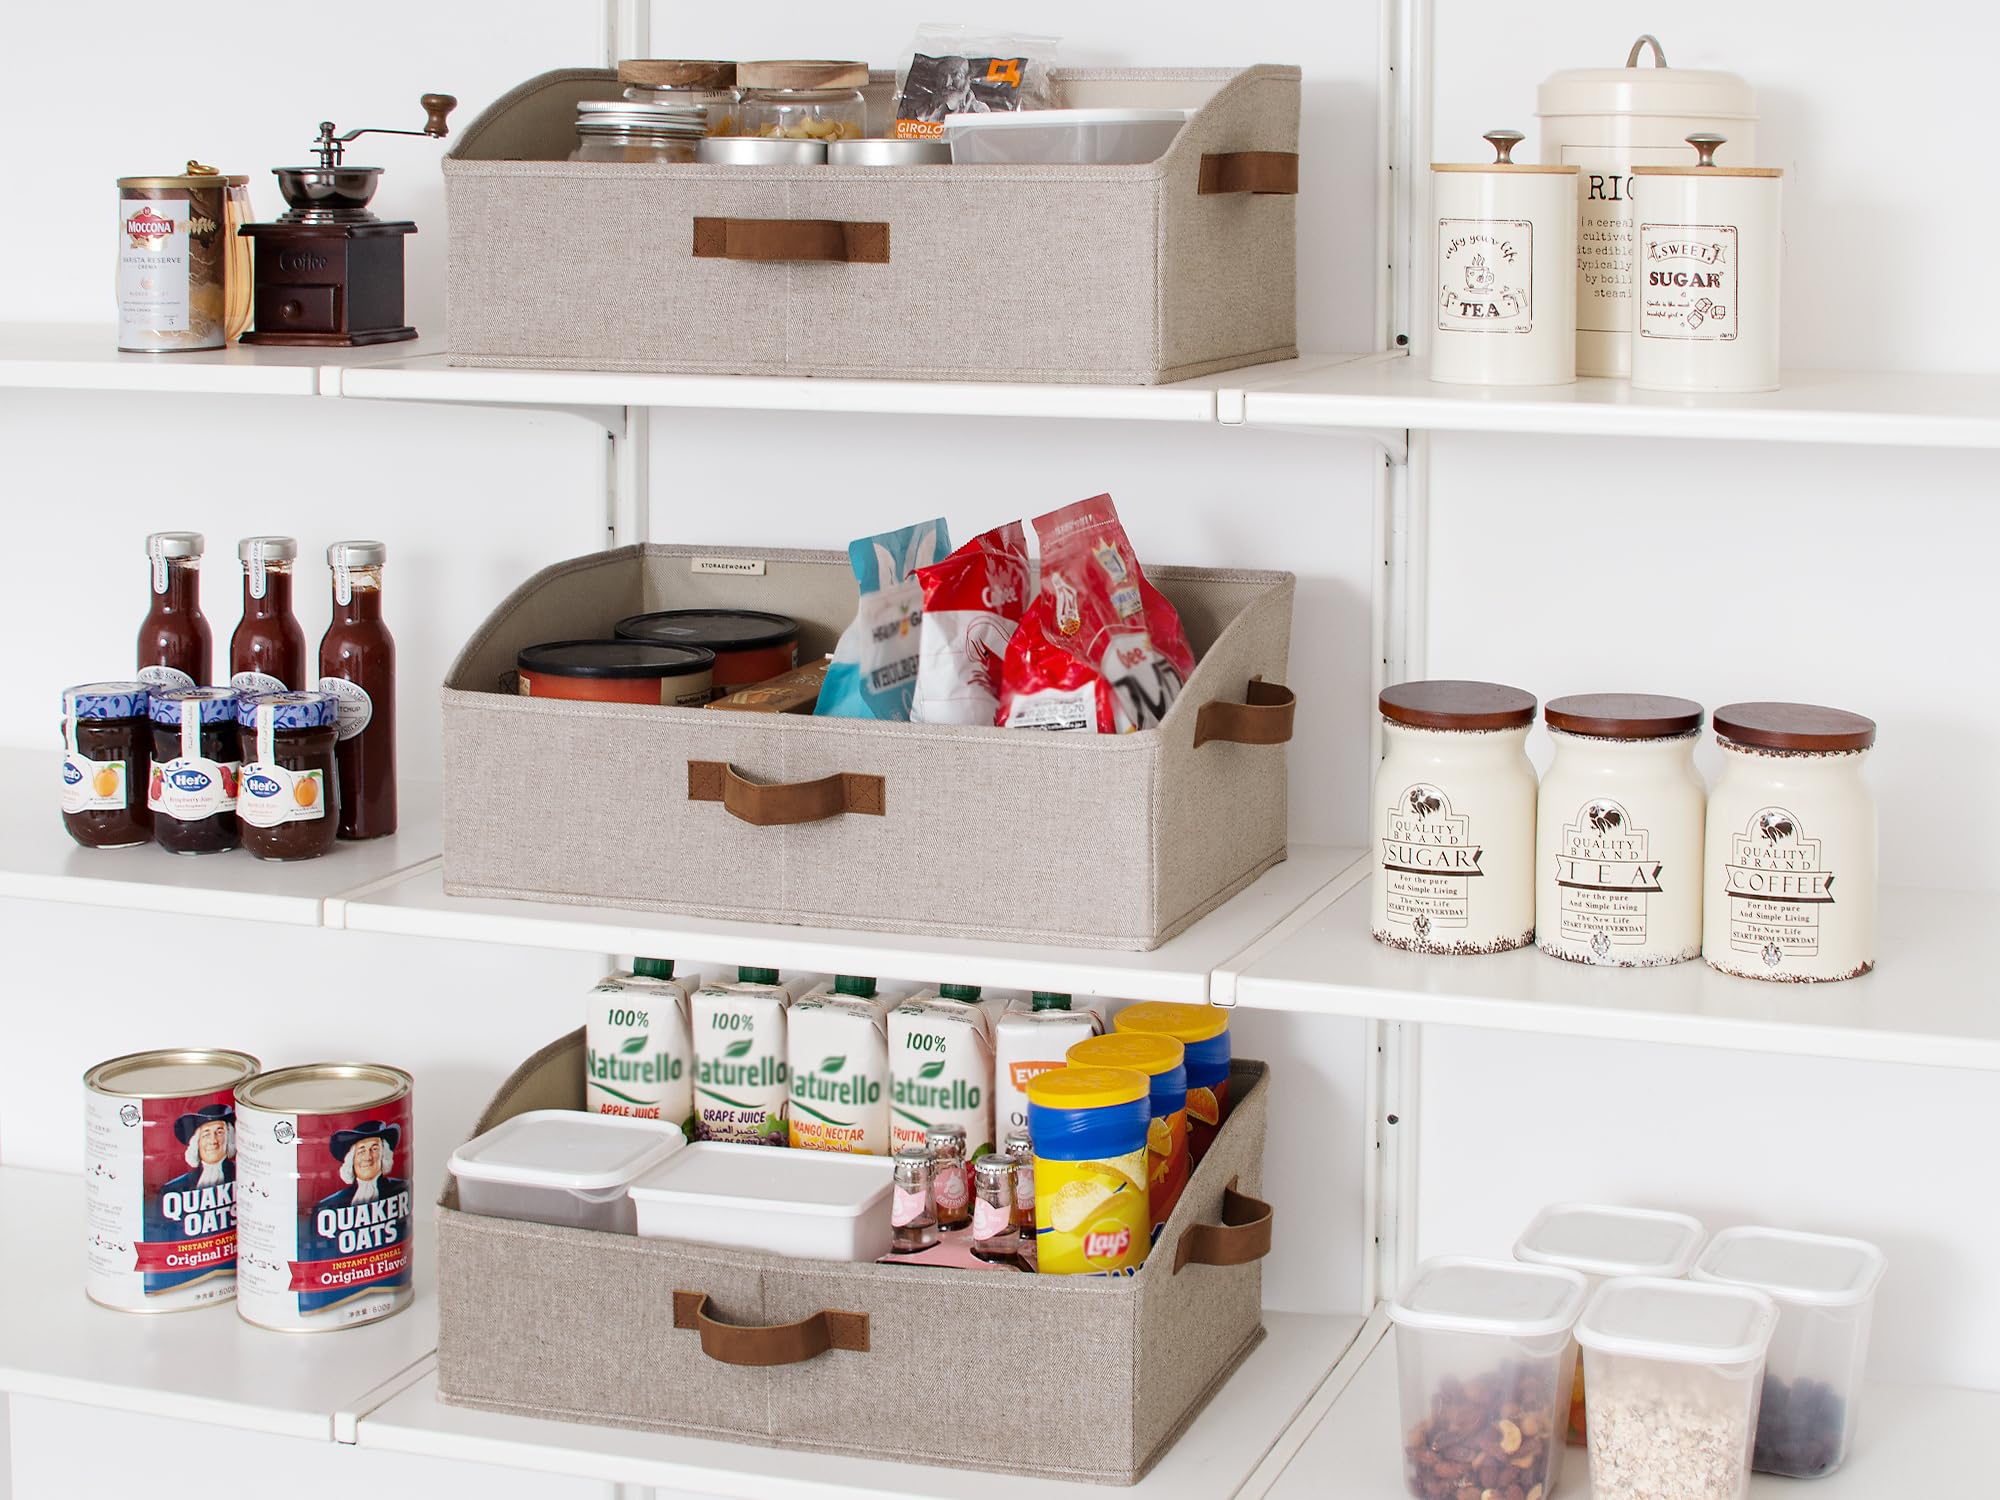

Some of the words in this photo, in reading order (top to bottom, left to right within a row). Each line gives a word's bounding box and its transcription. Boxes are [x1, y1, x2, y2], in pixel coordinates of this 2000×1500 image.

[1588, 175, 1633, 200] RI
[128, 221, 171, 233] MOCCONA
[1597, 218, 1633, 228] cereal
[1583, 231, 1633, 241] cultivat
[1661, 244, 1708, 257] SWEET
[1577, 258, 1632, 272] Typically
[1585, 273, 1597, 285] by
[1649, 271, 1721, 288] SUGAR
[1460, 302, 1500, 318] TEA
[175, 774, 209, 786] Hero
[249, 779, 278, 792] Hero
[1396, 821, 1454, 835] QUALITY
[1394, 832, 1459, 845] BRAND
[1573, 837, 1634, 850] QUALITY
[1388, 845, 1471, 867] SUGAR
[1571, 848, 1639, 860] BRAND
[1743, 846, 1807, 860] QUALITY
[1740, 858, 1811, 870] BRAND
[1565, 860, 1647, 884] TEA
[1400, 874, 1411, 882] For
[1414, 875, 1426, 883] the
[1429, 878, 1448, 886] pure
[1733, 871, 1823, 894] COFFEE
[1407, 885, 1430, 894] Simple
[1434, 886, 1458, 895] Living
[1577, 891, 1590, 899] For
[1593, 893, 1606, 901] the
[1609, 894, 1629, 902] pure
[1570, 900, 1582, 908] And
[1585, 902, 1610, 911] Simple
[1613, 904, 1638, 912] Living
[1747, 901, 1761, 909] For
[1764, 903, 1777, 911] the
[1780, 905, 1800, 913] pure
[1740, 910, 1753, 919] And
[1756, 912, 1782, 922] Simple
[1785, 915, 1810, 923] Living
[608, 1009, 649, 1028] 100%
[712, 1013, 753, 1031] 100%
[907, 1032, 946, 1053] 100%
[587, 1049, 682, 1084] Naturello
[601, 1104, 629, 1117] APPLE
[632, 1107, 660, 1119] JUICE
[704, 1109, 735, 1123] GRAPE
[738, 1110, 766, 1124] JUICE
[794, 1120, 821, 1137] MANGO
[825, 1128, 864, 1141] NECTAR
[317, 1191, 411, 1239] QUAKER
[338, 1219, 398, 1254] OATS
[178, 1241, 213, 1252] INSTANT
[166, 1247, 221, 1266] Original
[333, 1258, 368, 1270] INSTANT
[369, 1247, 402, 1262] OATMEAL
[321, 1268, 375, 1284] Original
[377, 1255, 408, 1274] Flavor
